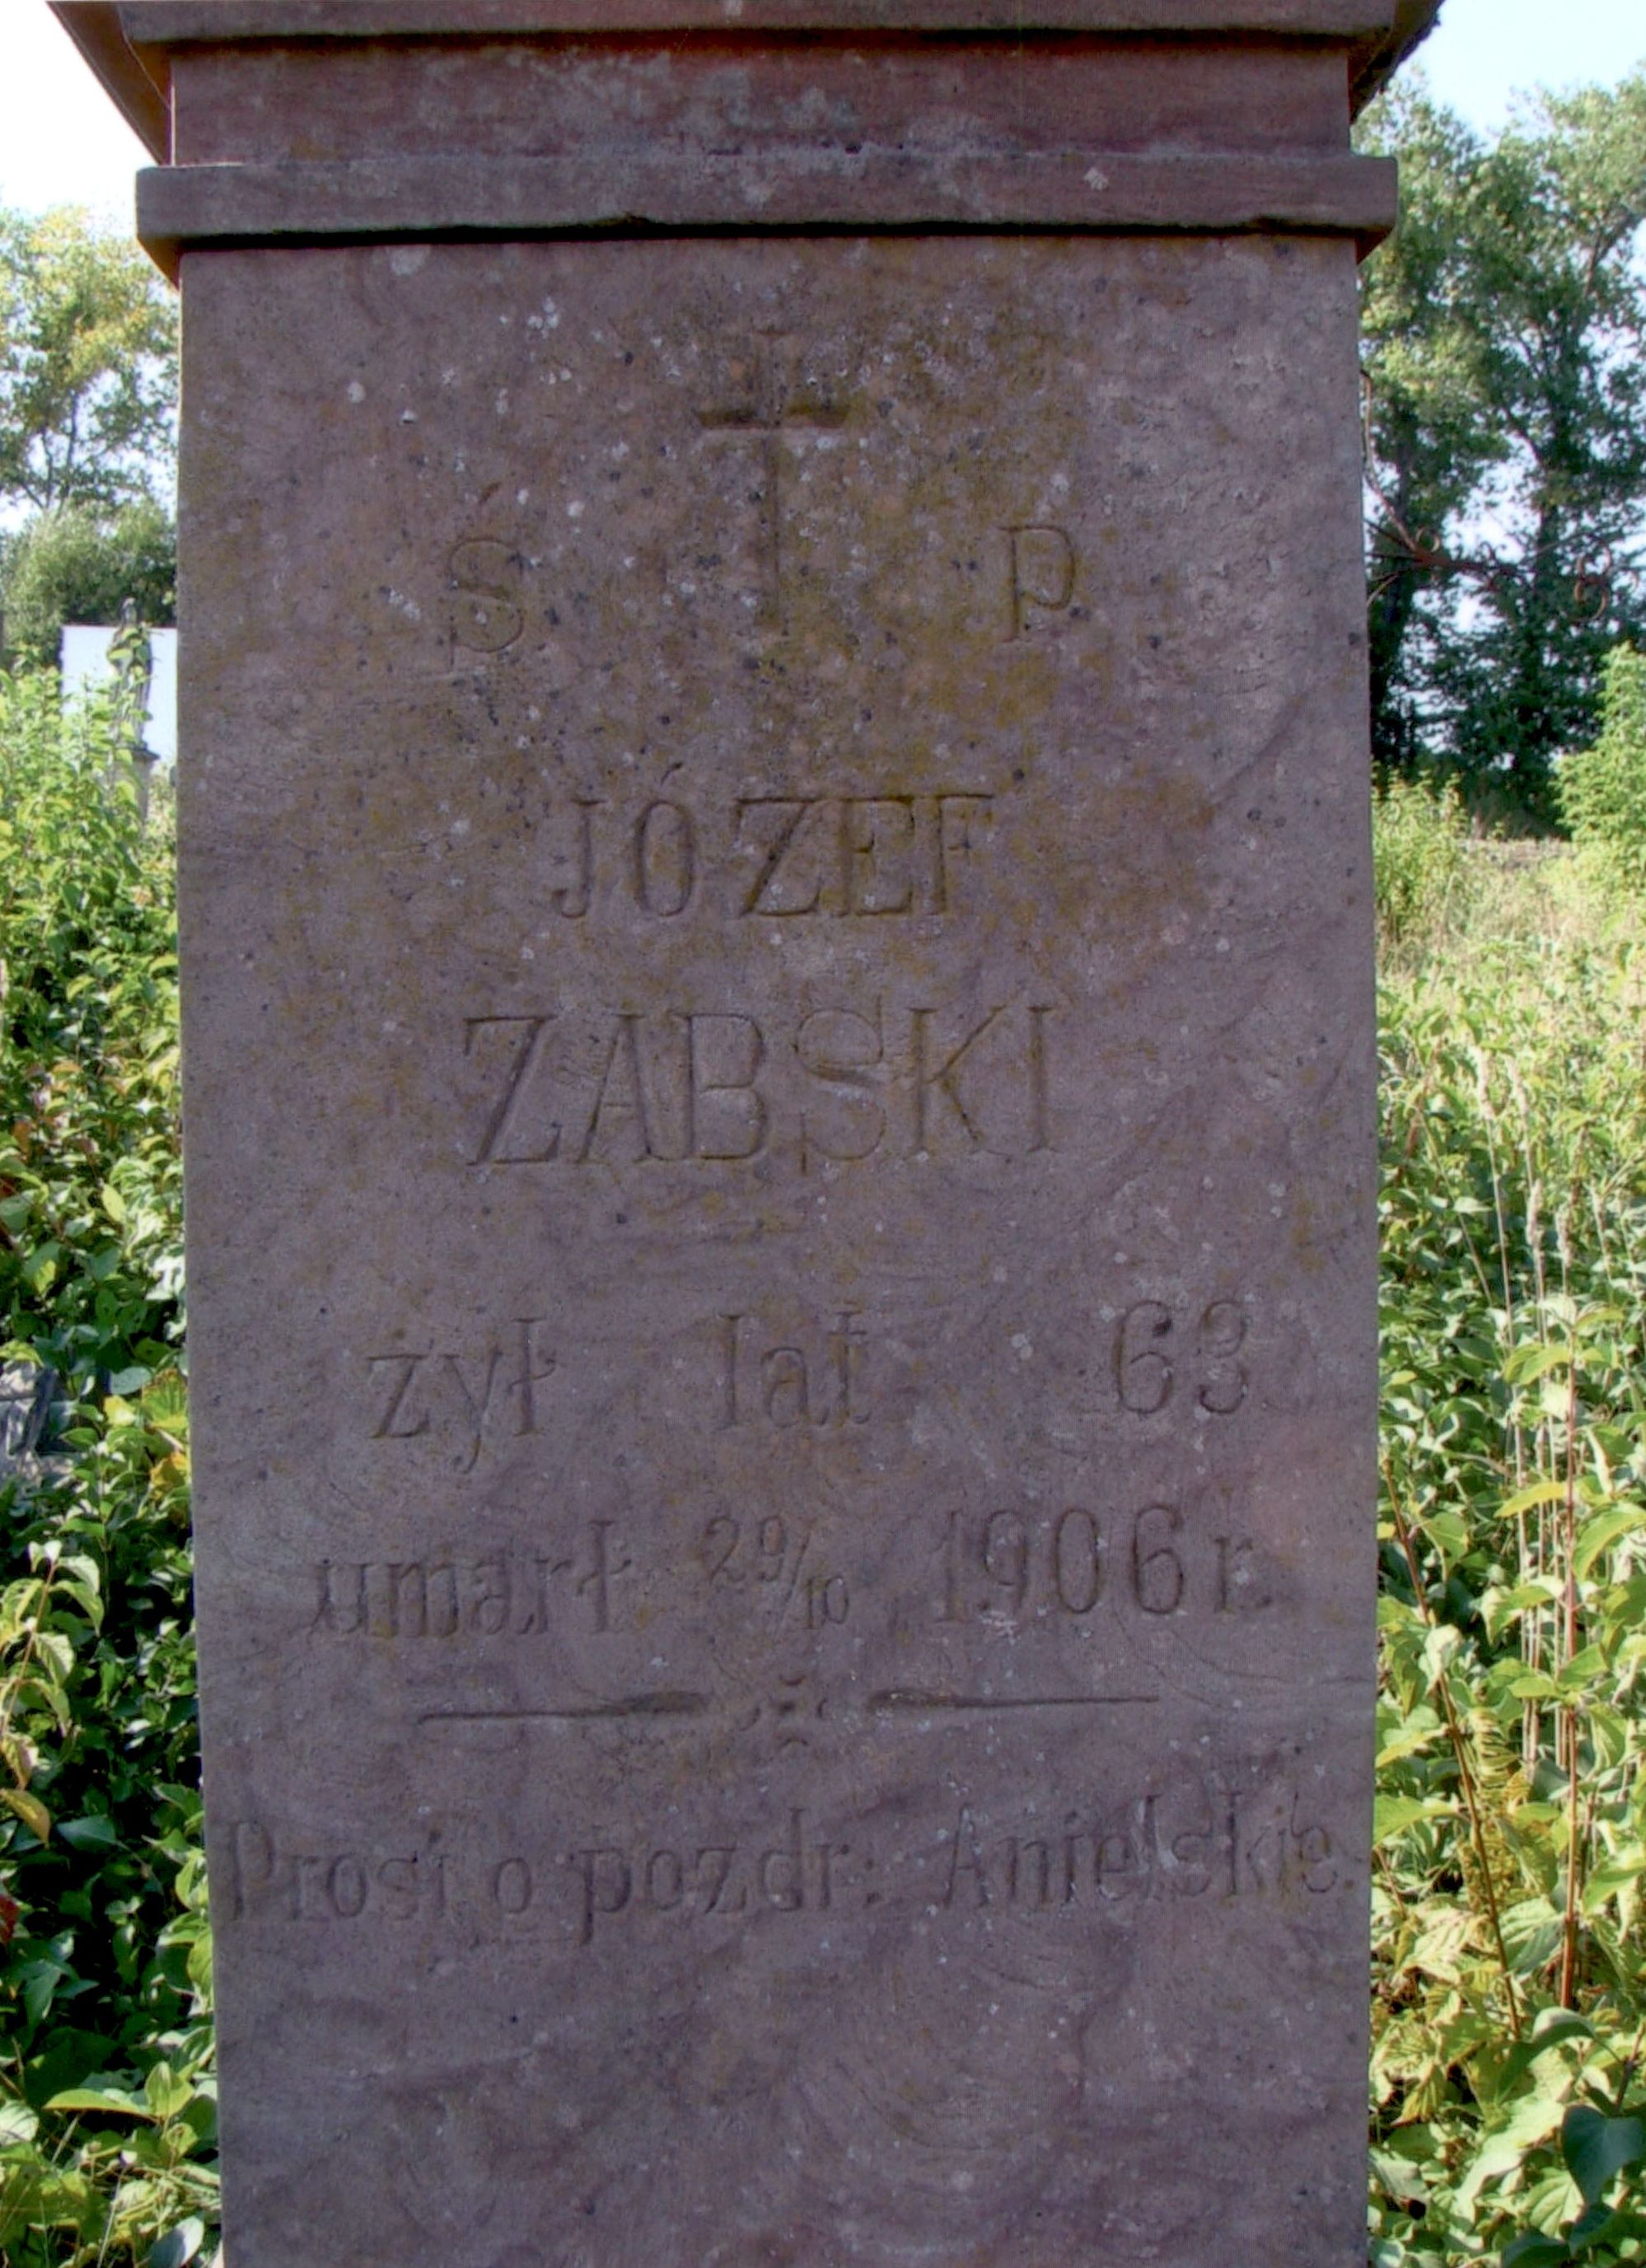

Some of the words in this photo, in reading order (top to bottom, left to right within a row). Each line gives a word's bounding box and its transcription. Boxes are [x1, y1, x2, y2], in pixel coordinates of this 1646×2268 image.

[550, 760, 994, 920] JÓZEF
[715, 1314, 871, 1432] lat
[1113, 1299, 1249, 1415] 63
[929, 1506, 1185, 1625] 1906
[231, 1818, 451, 1924] Prosi
[494, 1855, 532, 1916] o
